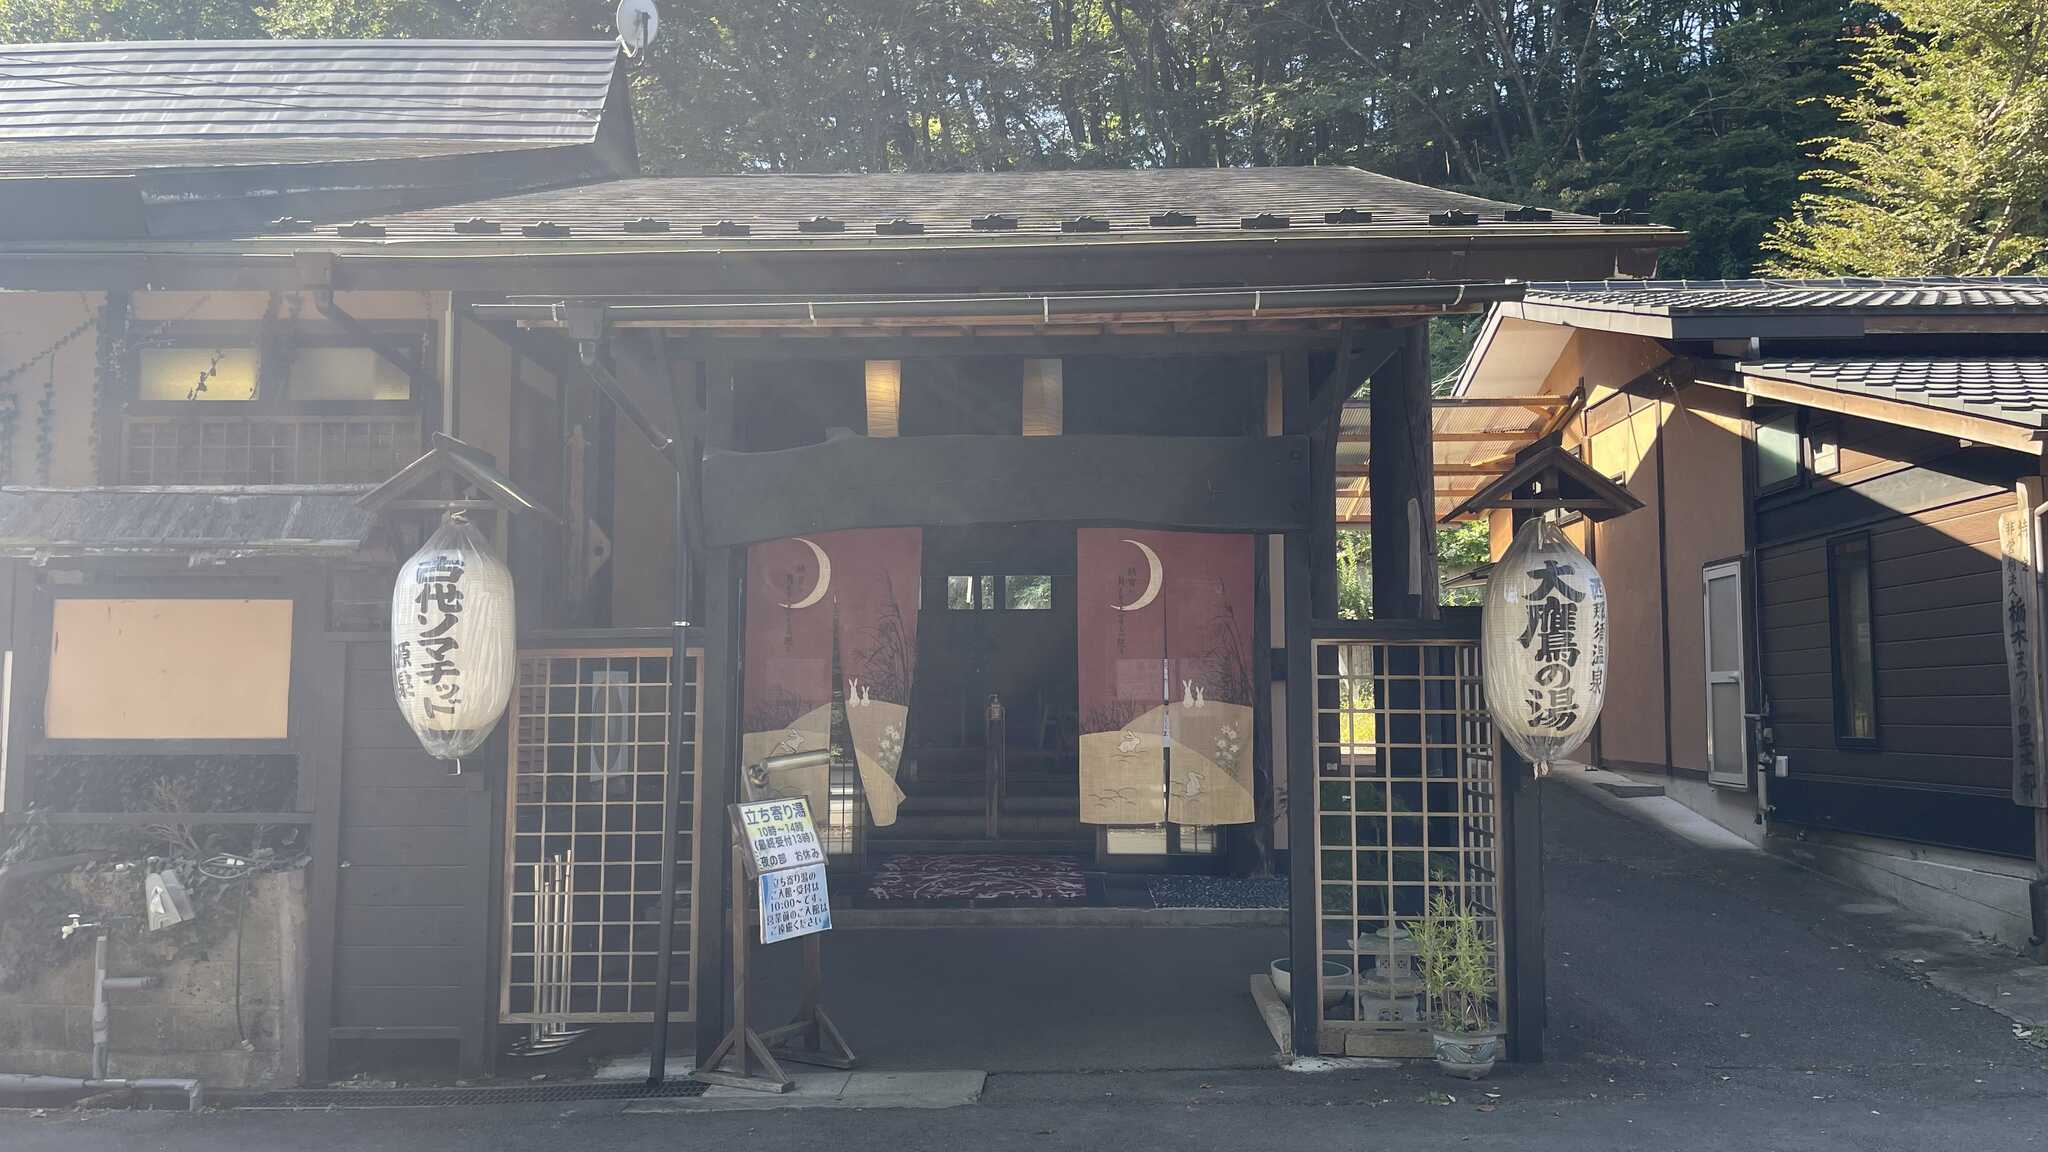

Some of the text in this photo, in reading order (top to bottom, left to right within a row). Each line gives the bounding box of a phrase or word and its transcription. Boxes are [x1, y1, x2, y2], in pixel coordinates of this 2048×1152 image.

[1518, 560, 1585, 731] 大鷹の湯
[1590, 576, 1607, 694] 西那須温泉
[745, 802, 806, 825] 立ち寄り湯
[760, 848, 819, 867] 夜の部 お休み
